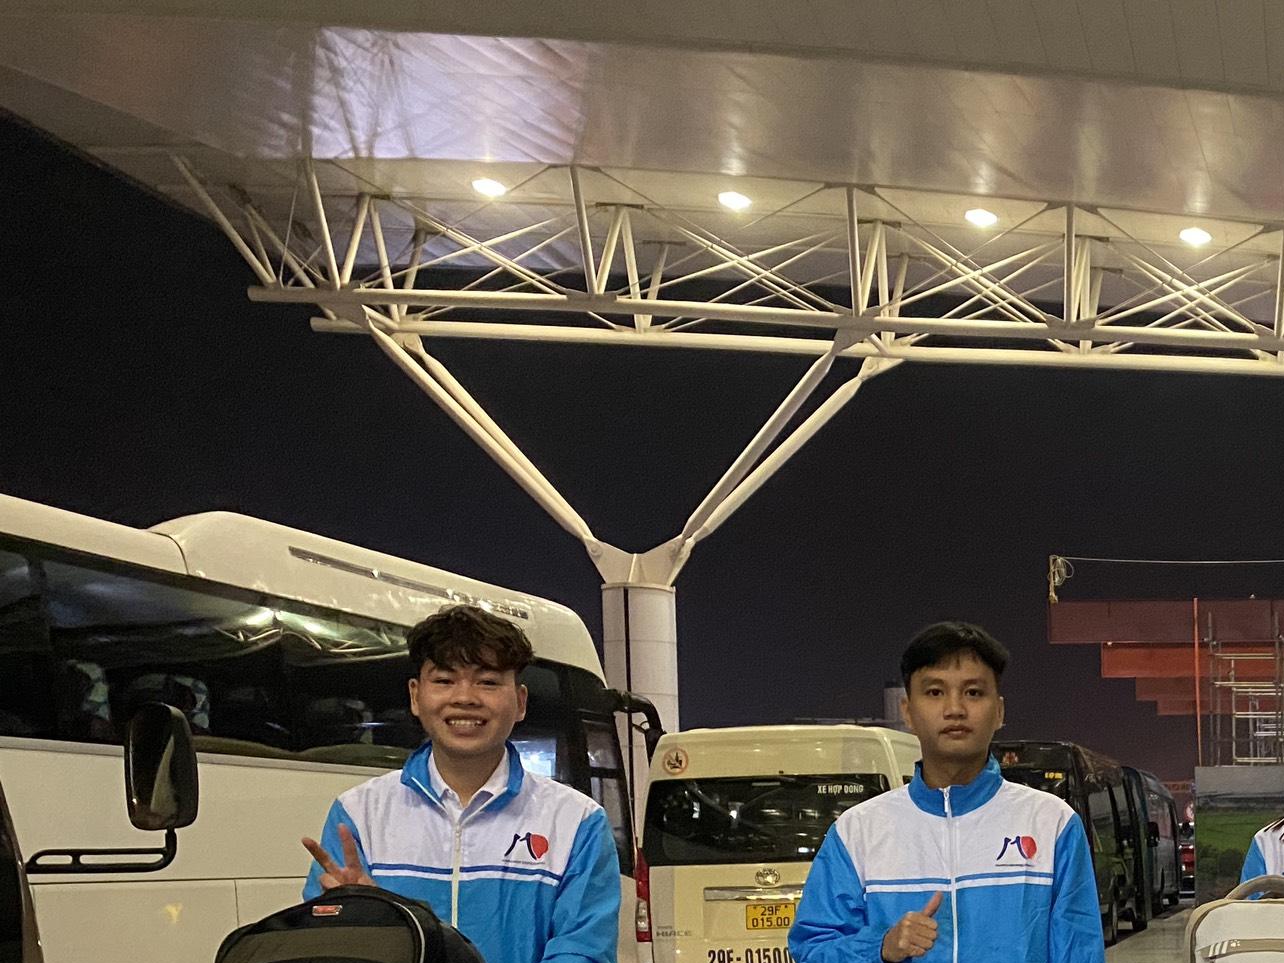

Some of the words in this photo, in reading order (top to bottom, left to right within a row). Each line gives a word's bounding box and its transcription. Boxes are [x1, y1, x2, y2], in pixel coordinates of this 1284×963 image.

[817, 785, 827, 794] XE
[760, 905, 781, 917] 29F
[751, 916, 790, 928] 015.00
